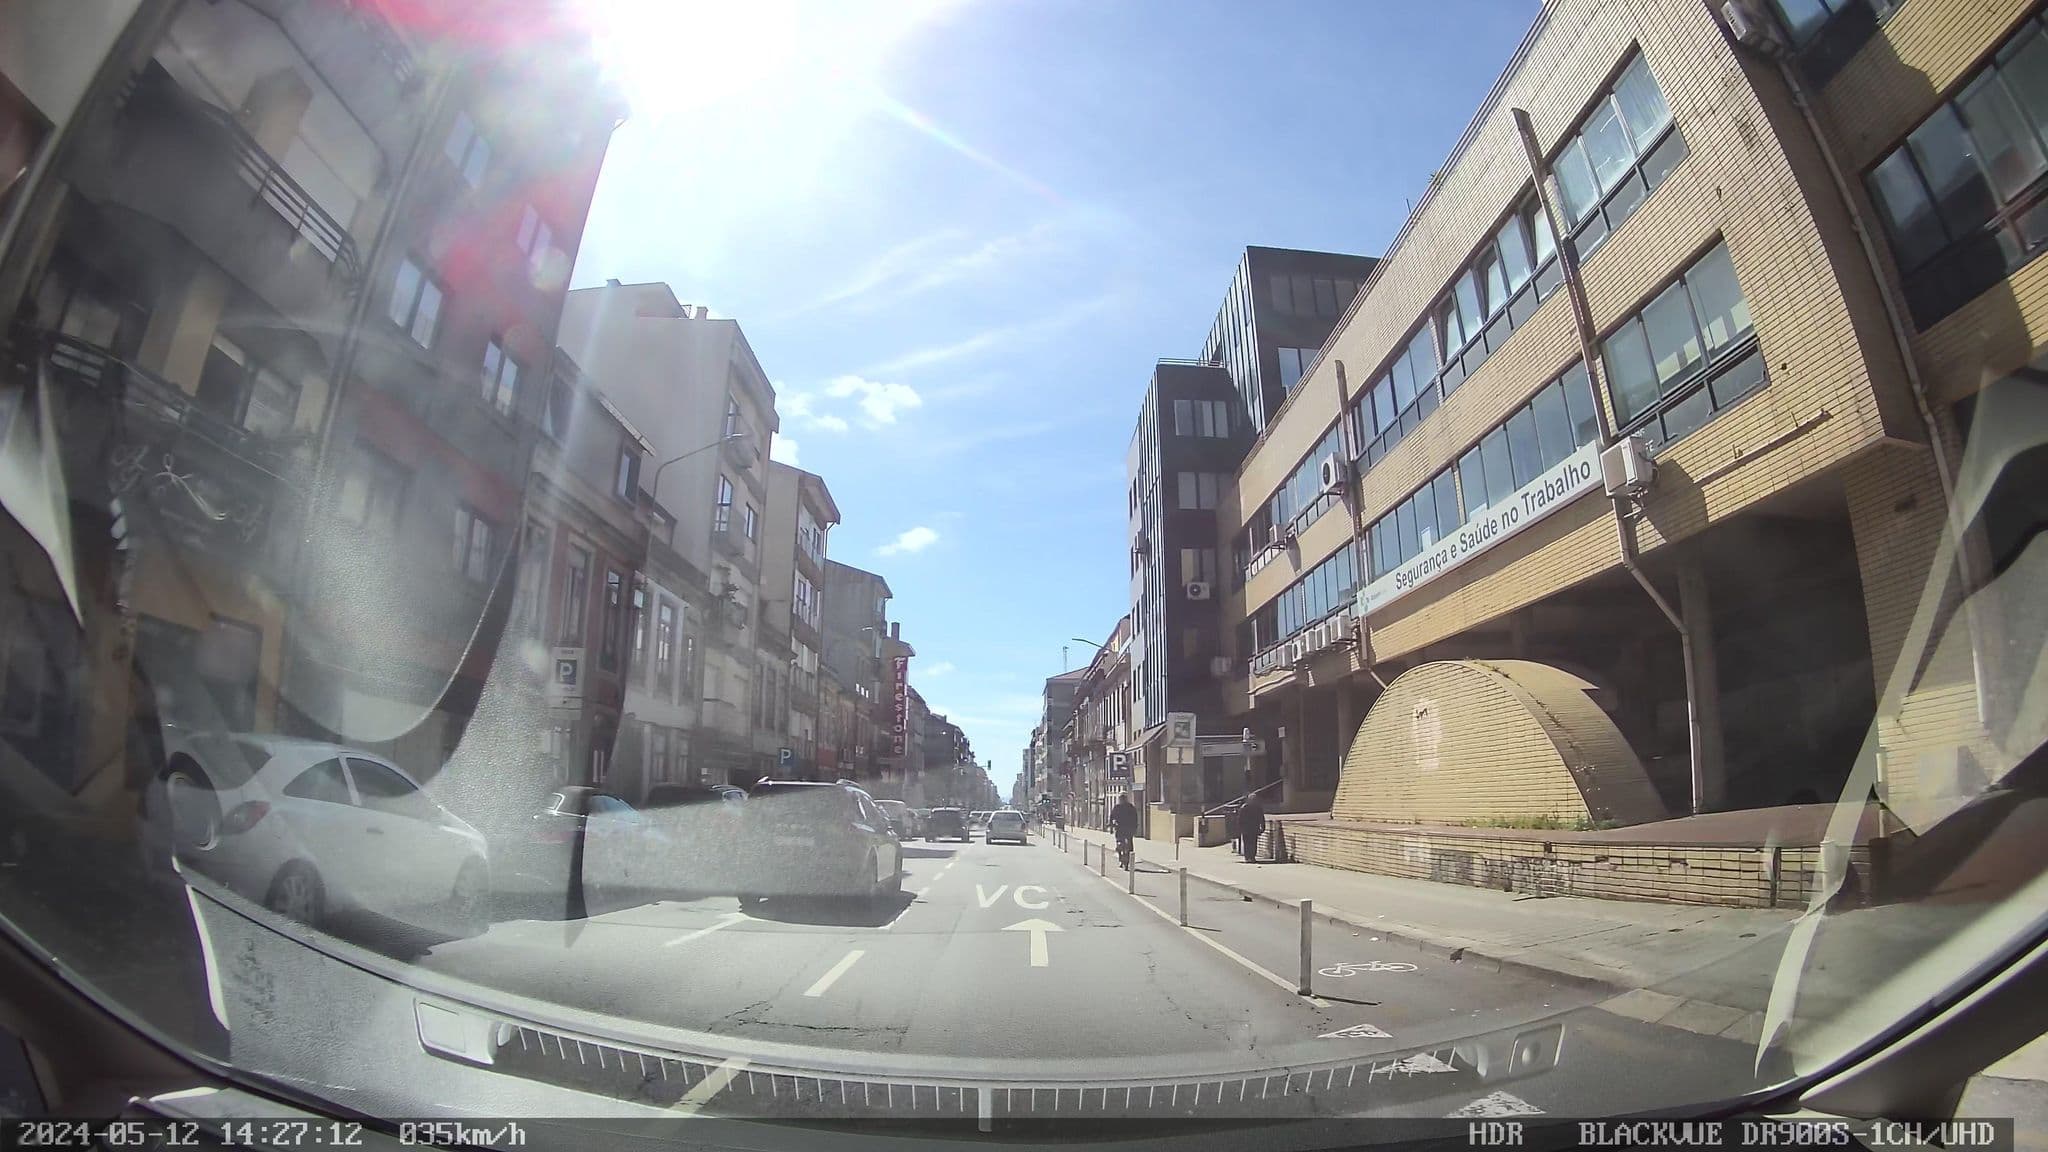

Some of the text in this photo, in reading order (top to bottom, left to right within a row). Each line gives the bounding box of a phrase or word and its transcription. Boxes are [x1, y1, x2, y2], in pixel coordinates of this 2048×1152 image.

[1396, 461, 1591, 590] Segurança e Saúde no Trabalho
[559, 662, 573, 682] P
[894, 657, 906, 754] Firestone
[780, 749, 791, 764] P
[1113, 754, 1127, 771] P
[975, 884, 1049, 910] VC
